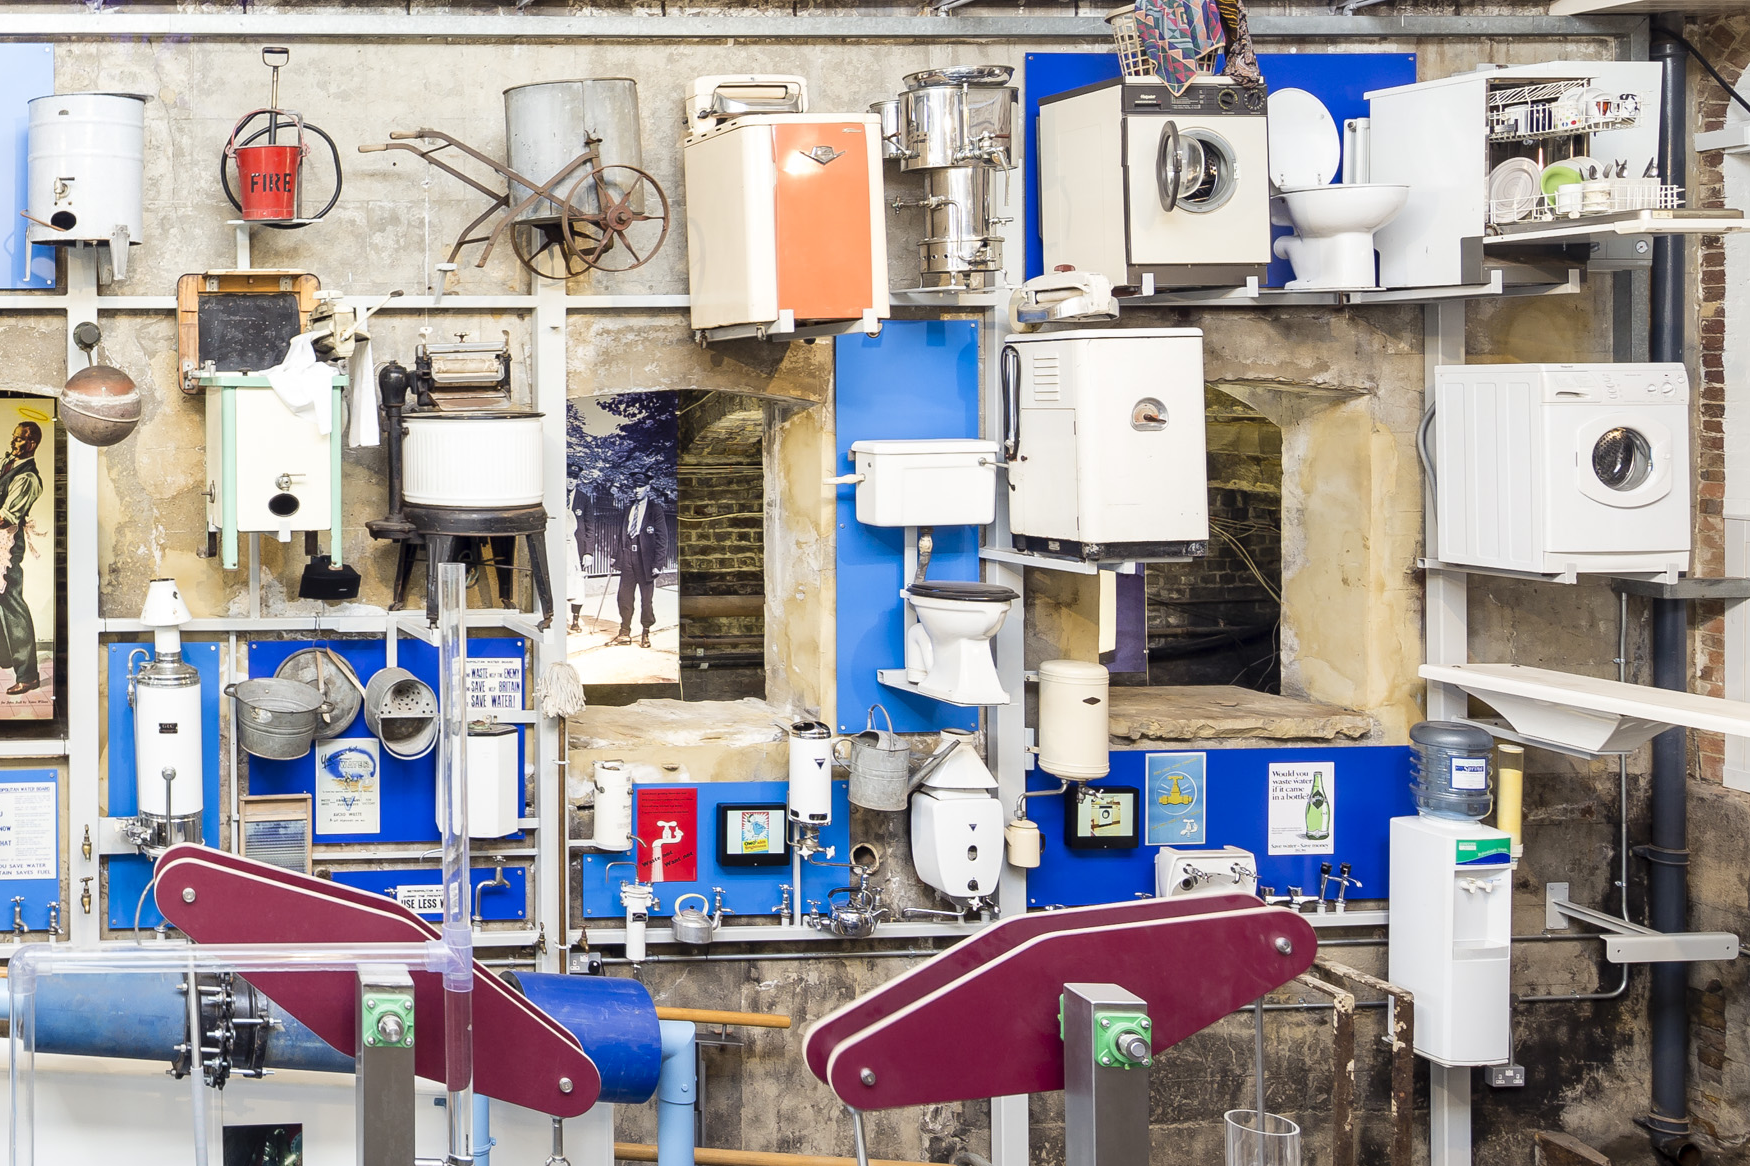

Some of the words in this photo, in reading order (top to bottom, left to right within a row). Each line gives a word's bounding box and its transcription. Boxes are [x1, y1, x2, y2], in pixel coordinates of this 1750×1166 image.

[251, 173, 292, 193] FIRE
[471, 668, 488, 679] WASTE
[504, 667, 520, 679] ENEMY
[471, 681, 485, 693] SAVE
[499, 681, 520, 693] BRITAIN
[471, 695, 487, 708] SAVE
[491, 695, 516, 708] WATER!
[1295, 771, 1309, 779] you
[662, 850, 673, 858] not
[664, 857, 681, 867] Want
[682, 851, 693, 859] not
[418, 899, 437, 909] LESS
